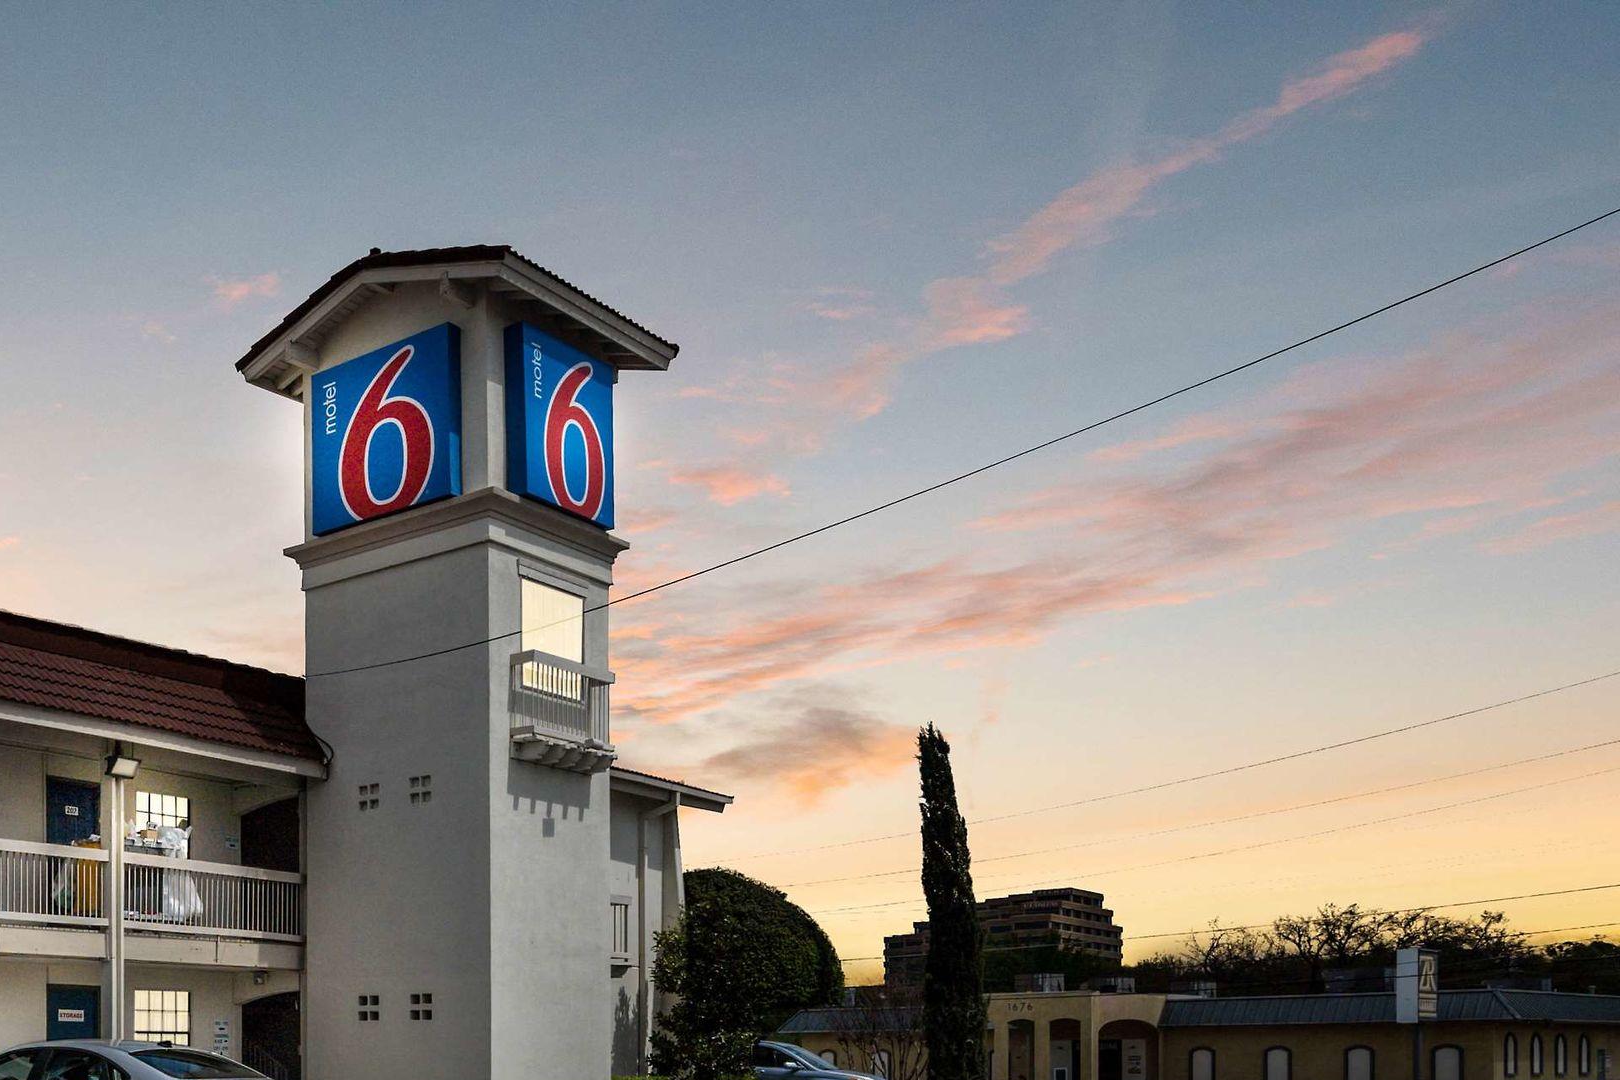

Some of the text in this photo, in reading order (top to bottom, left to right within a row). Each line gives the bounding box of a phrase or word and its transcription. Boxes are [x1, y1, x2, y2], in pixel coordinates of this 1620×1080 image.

[532, 342, 542, 399] motel
[323, 381, 337, 435] motel
[338, 344, 435, 521] 6
[544, 361, 606, 521] 6
[1007, 1001, 1034, 1013] 1676
